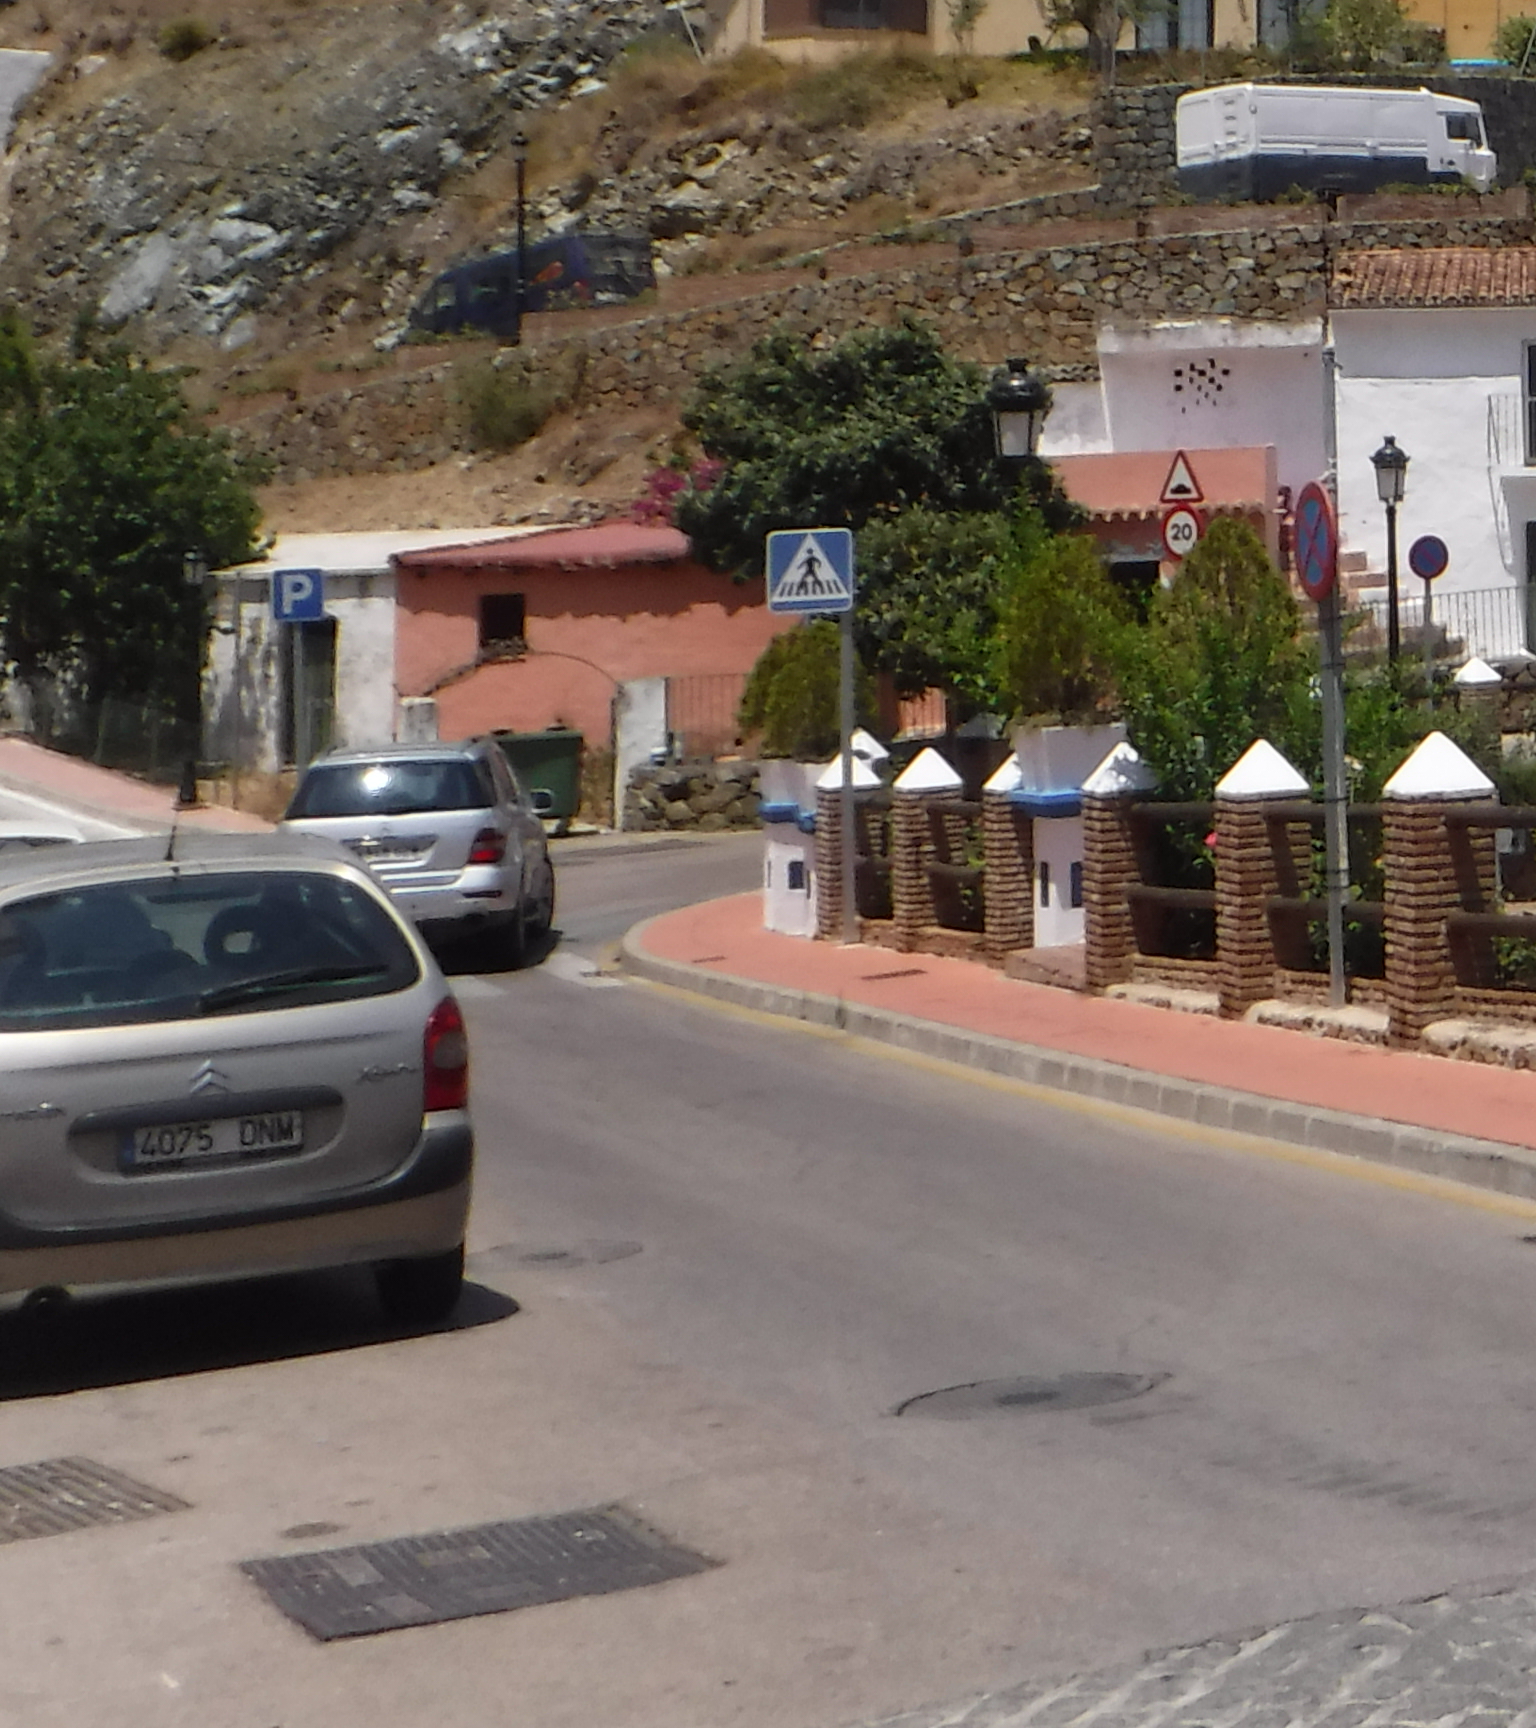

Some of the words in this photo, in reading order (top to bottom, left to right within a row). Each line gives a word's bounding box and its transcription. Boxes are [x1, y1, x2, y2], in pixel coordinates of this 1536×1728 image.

[1170, 523, 1193, 540] 20
[282, 574, 314, 614] P
[141, 1124, 213, 1156] 4075
